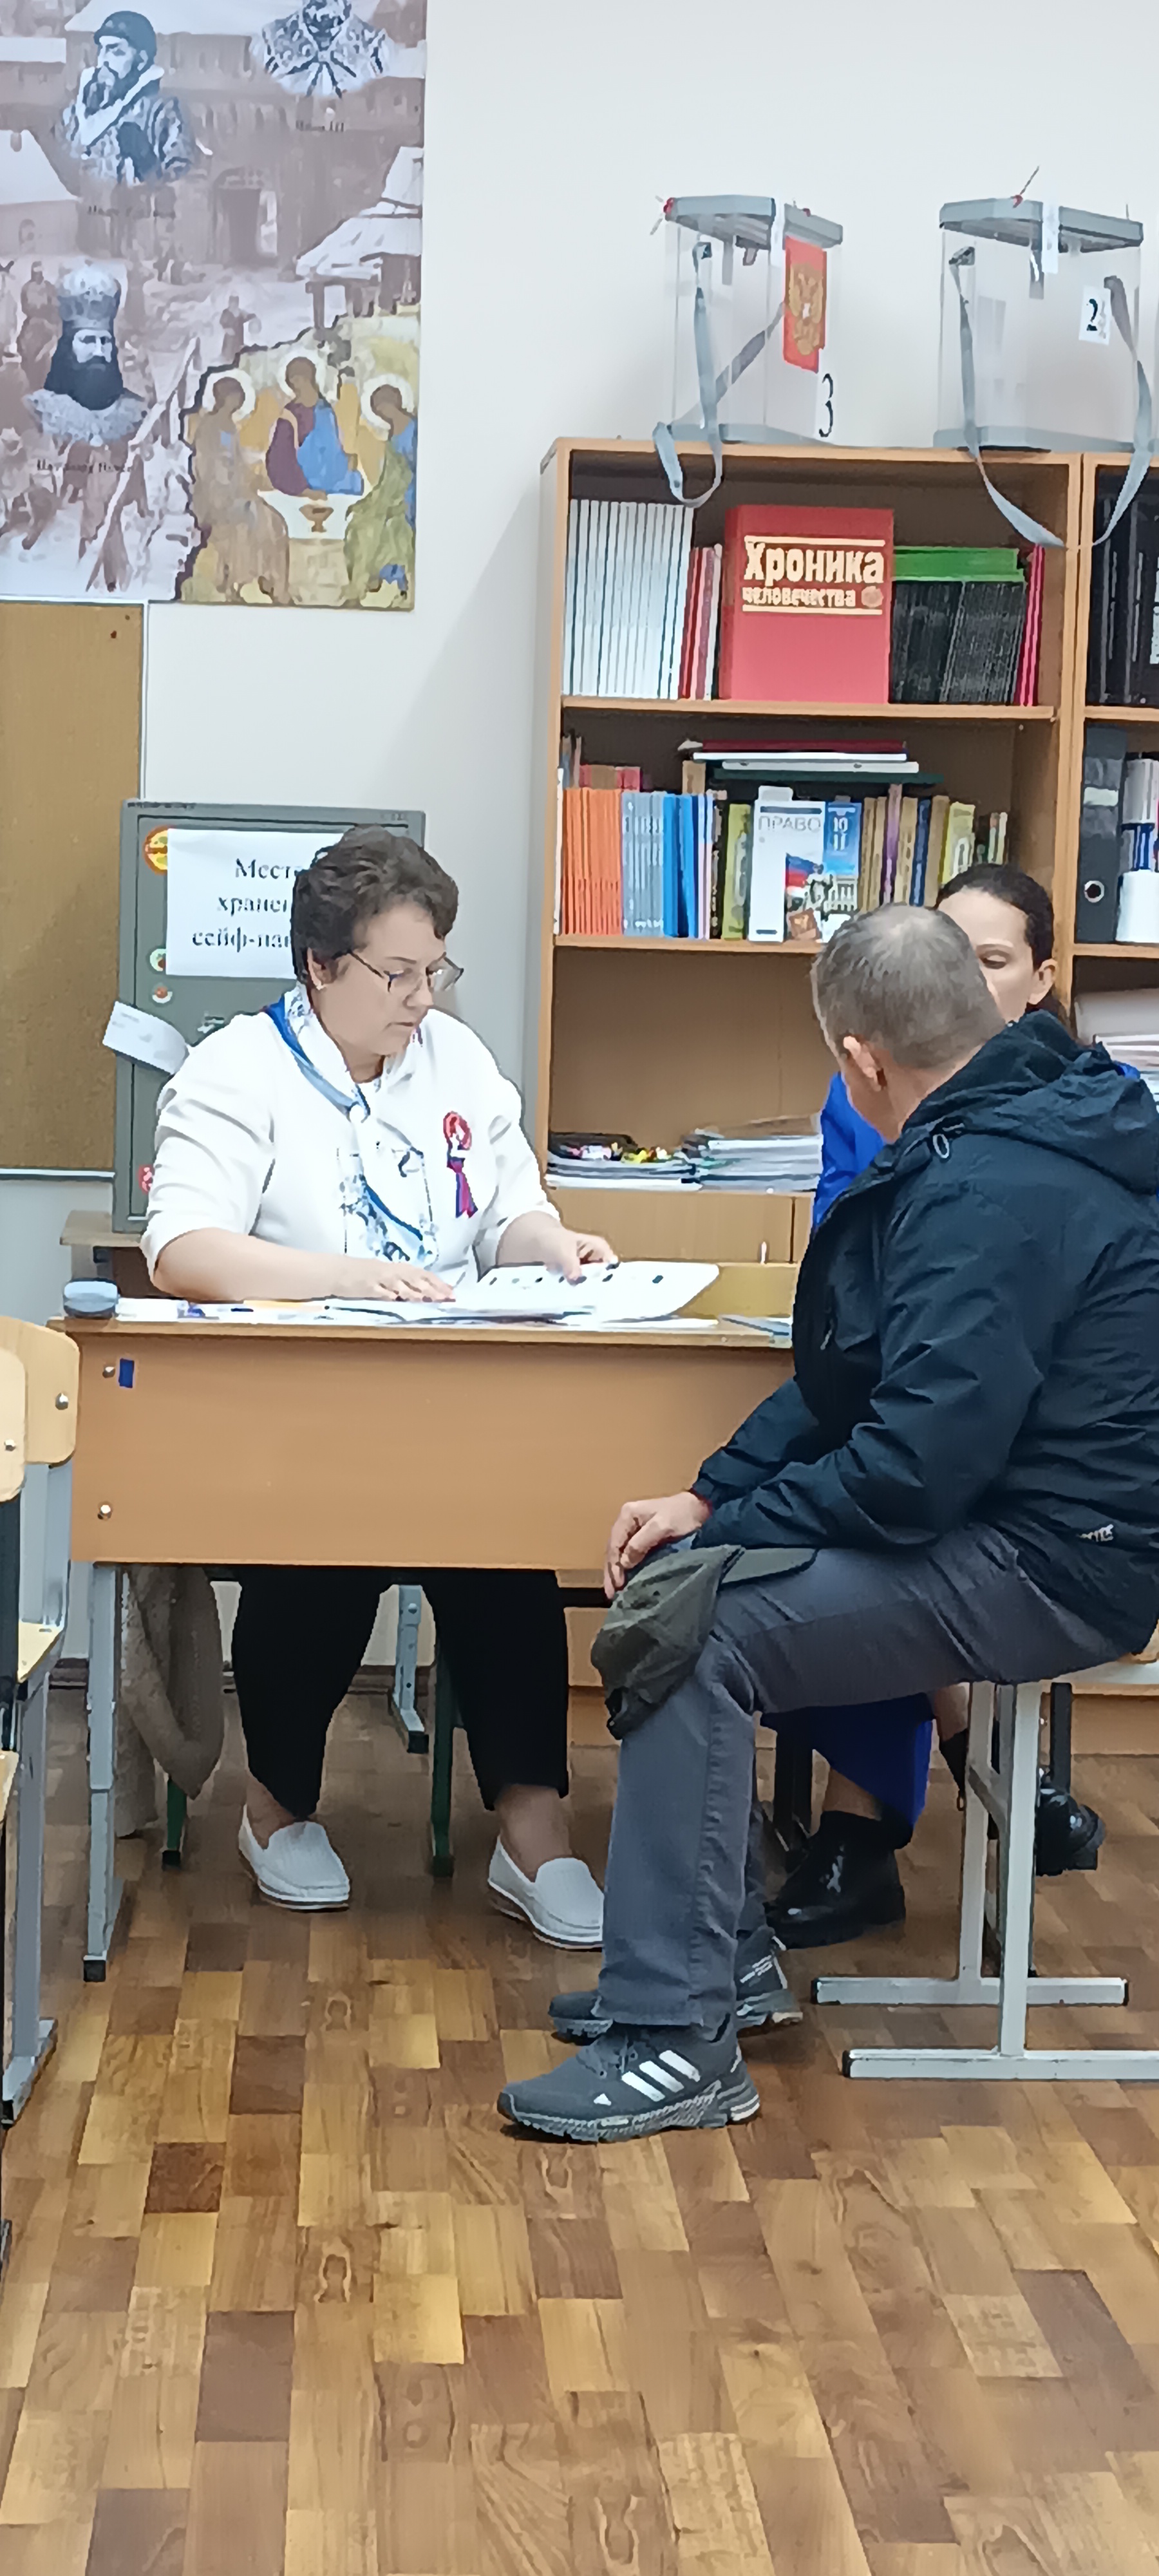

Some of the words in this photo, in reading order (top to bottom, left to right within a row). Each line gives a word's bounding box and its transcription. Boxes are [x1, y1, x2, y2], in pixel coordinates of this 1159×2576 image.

[818, 373, 834, 438] 3
[744, 542, 885, 587] Хроника
[742, 587, 856, 607] человечества
[758, 815, 822, 833] ПРАВО
[833, 817, 849, 832] 10
[234, 858, 296, 879] Мест
